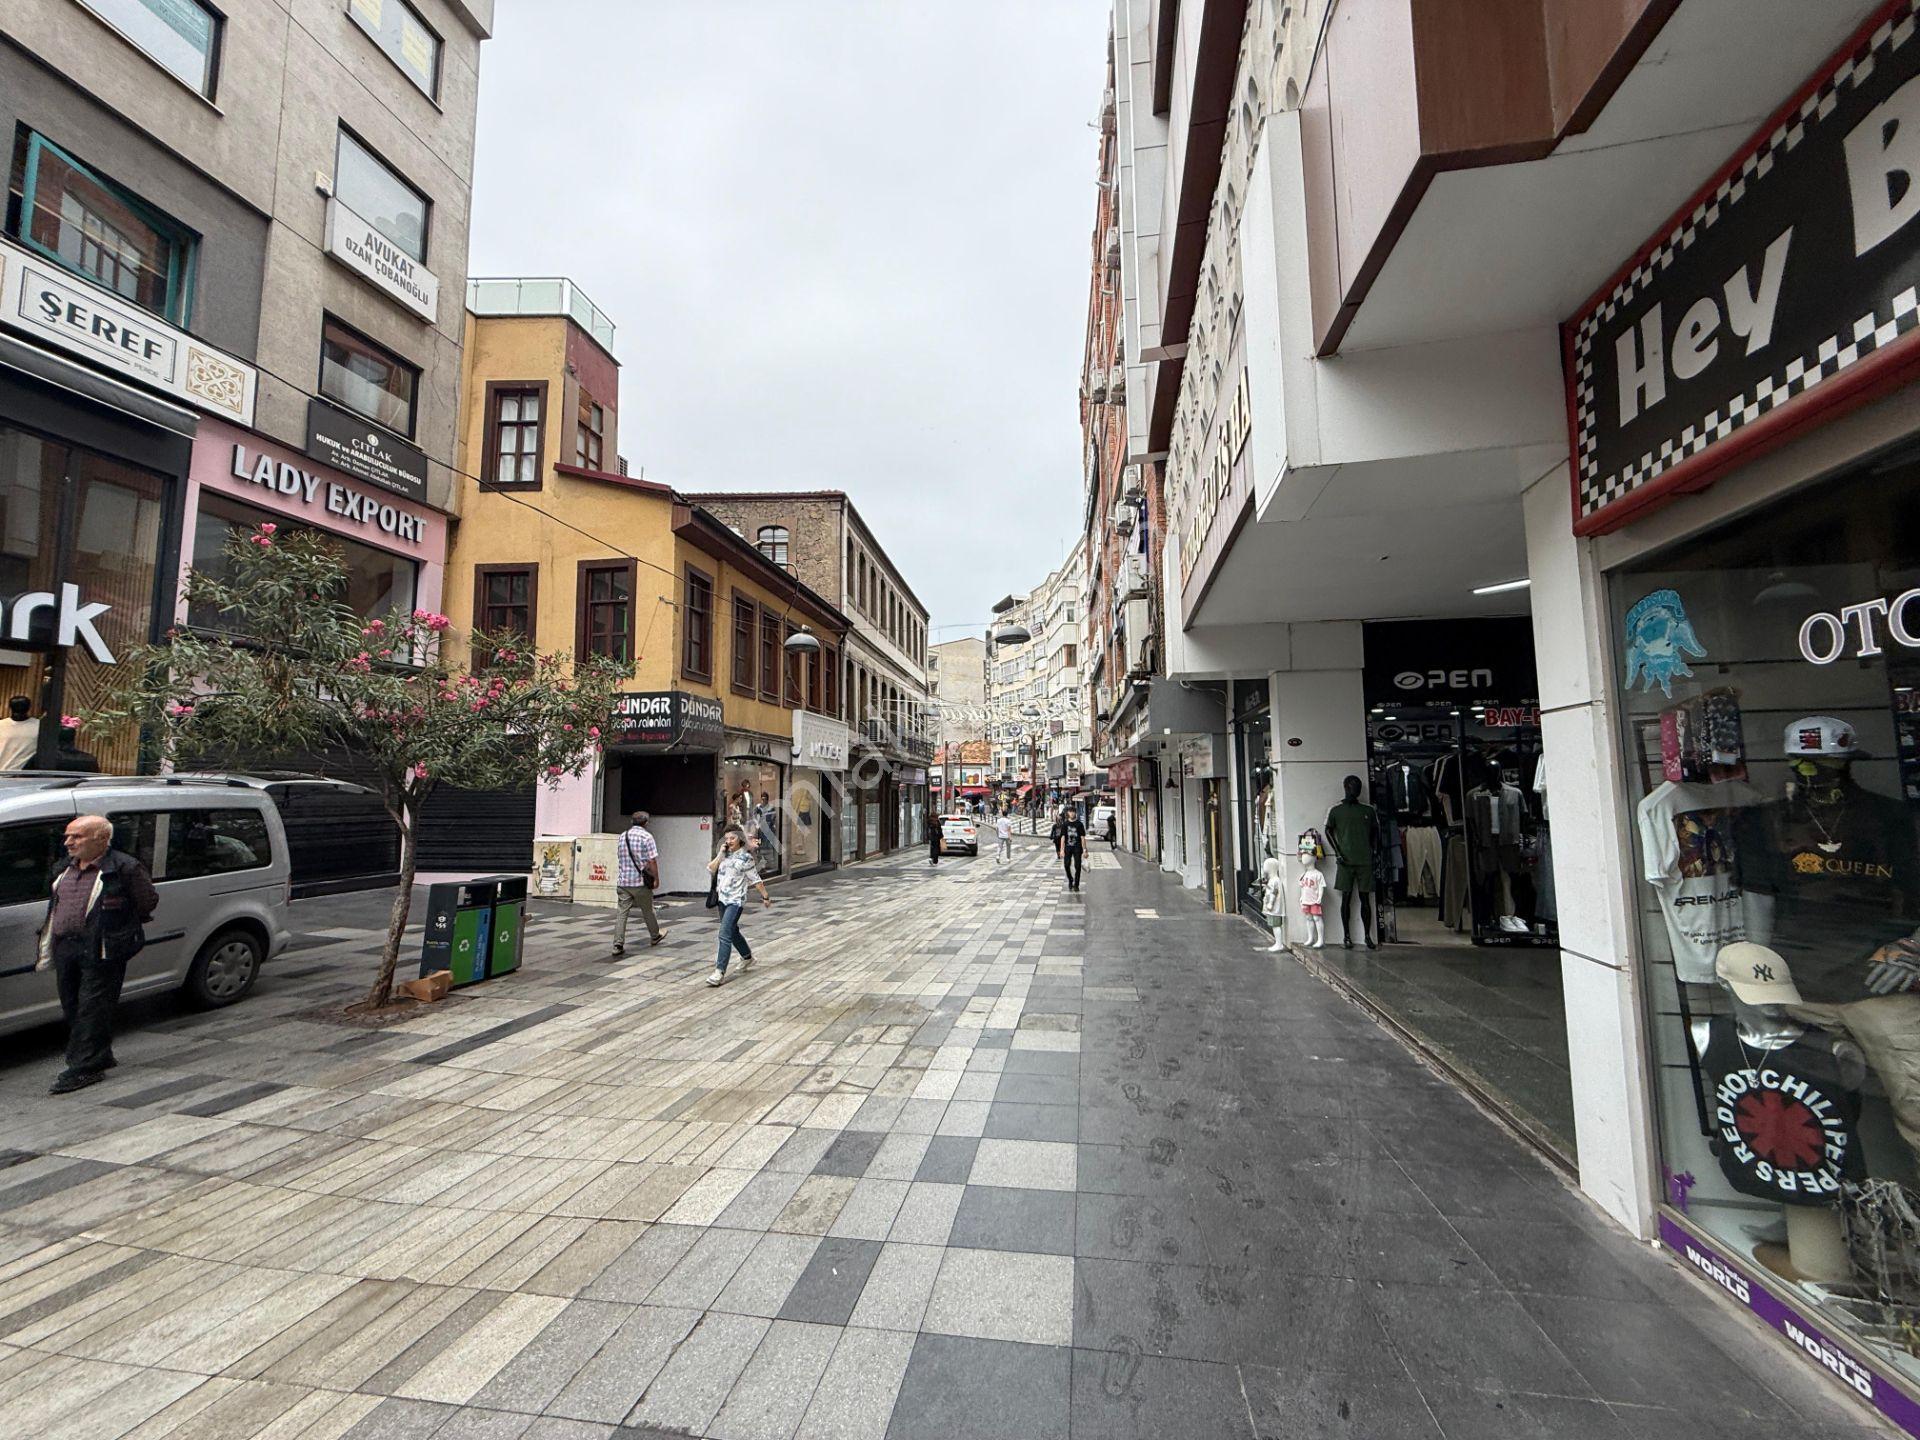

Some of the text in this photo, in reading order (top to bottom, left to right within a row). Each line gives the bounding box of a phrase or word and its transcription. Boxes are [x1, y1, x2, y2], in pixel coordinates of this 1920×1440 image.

[345, 236, 429, 306] OZAN ÇOBANOĞLU
[364, 232, 414, 280] AVUKAT
[39, 290, 162, 362] ŞEREF
[315, 433, 342, 450] HUKUK
[350, 449, 398, 474] ARABULUCULUK
[398, 468, 422, 485] BÜROSU
[351, 437, 393, 463] ÇITLAK
[233, 444, 427, 543] LADY EXPORT
[0, 582, 117, 664] rk
[681, 698, 723, 722] DÜNDAR
[1825, 858, 1893, 879] QUEEN
[1716, 1068, 1760, 1107] HOT
[1760, 1068, 1844, 1127] CHILI
[1716, 1106, 1756, 1164] RED
[1685, 1244, 1750, 1304] WORLD
[1783, 1319, 1873, 1399] WORLD
